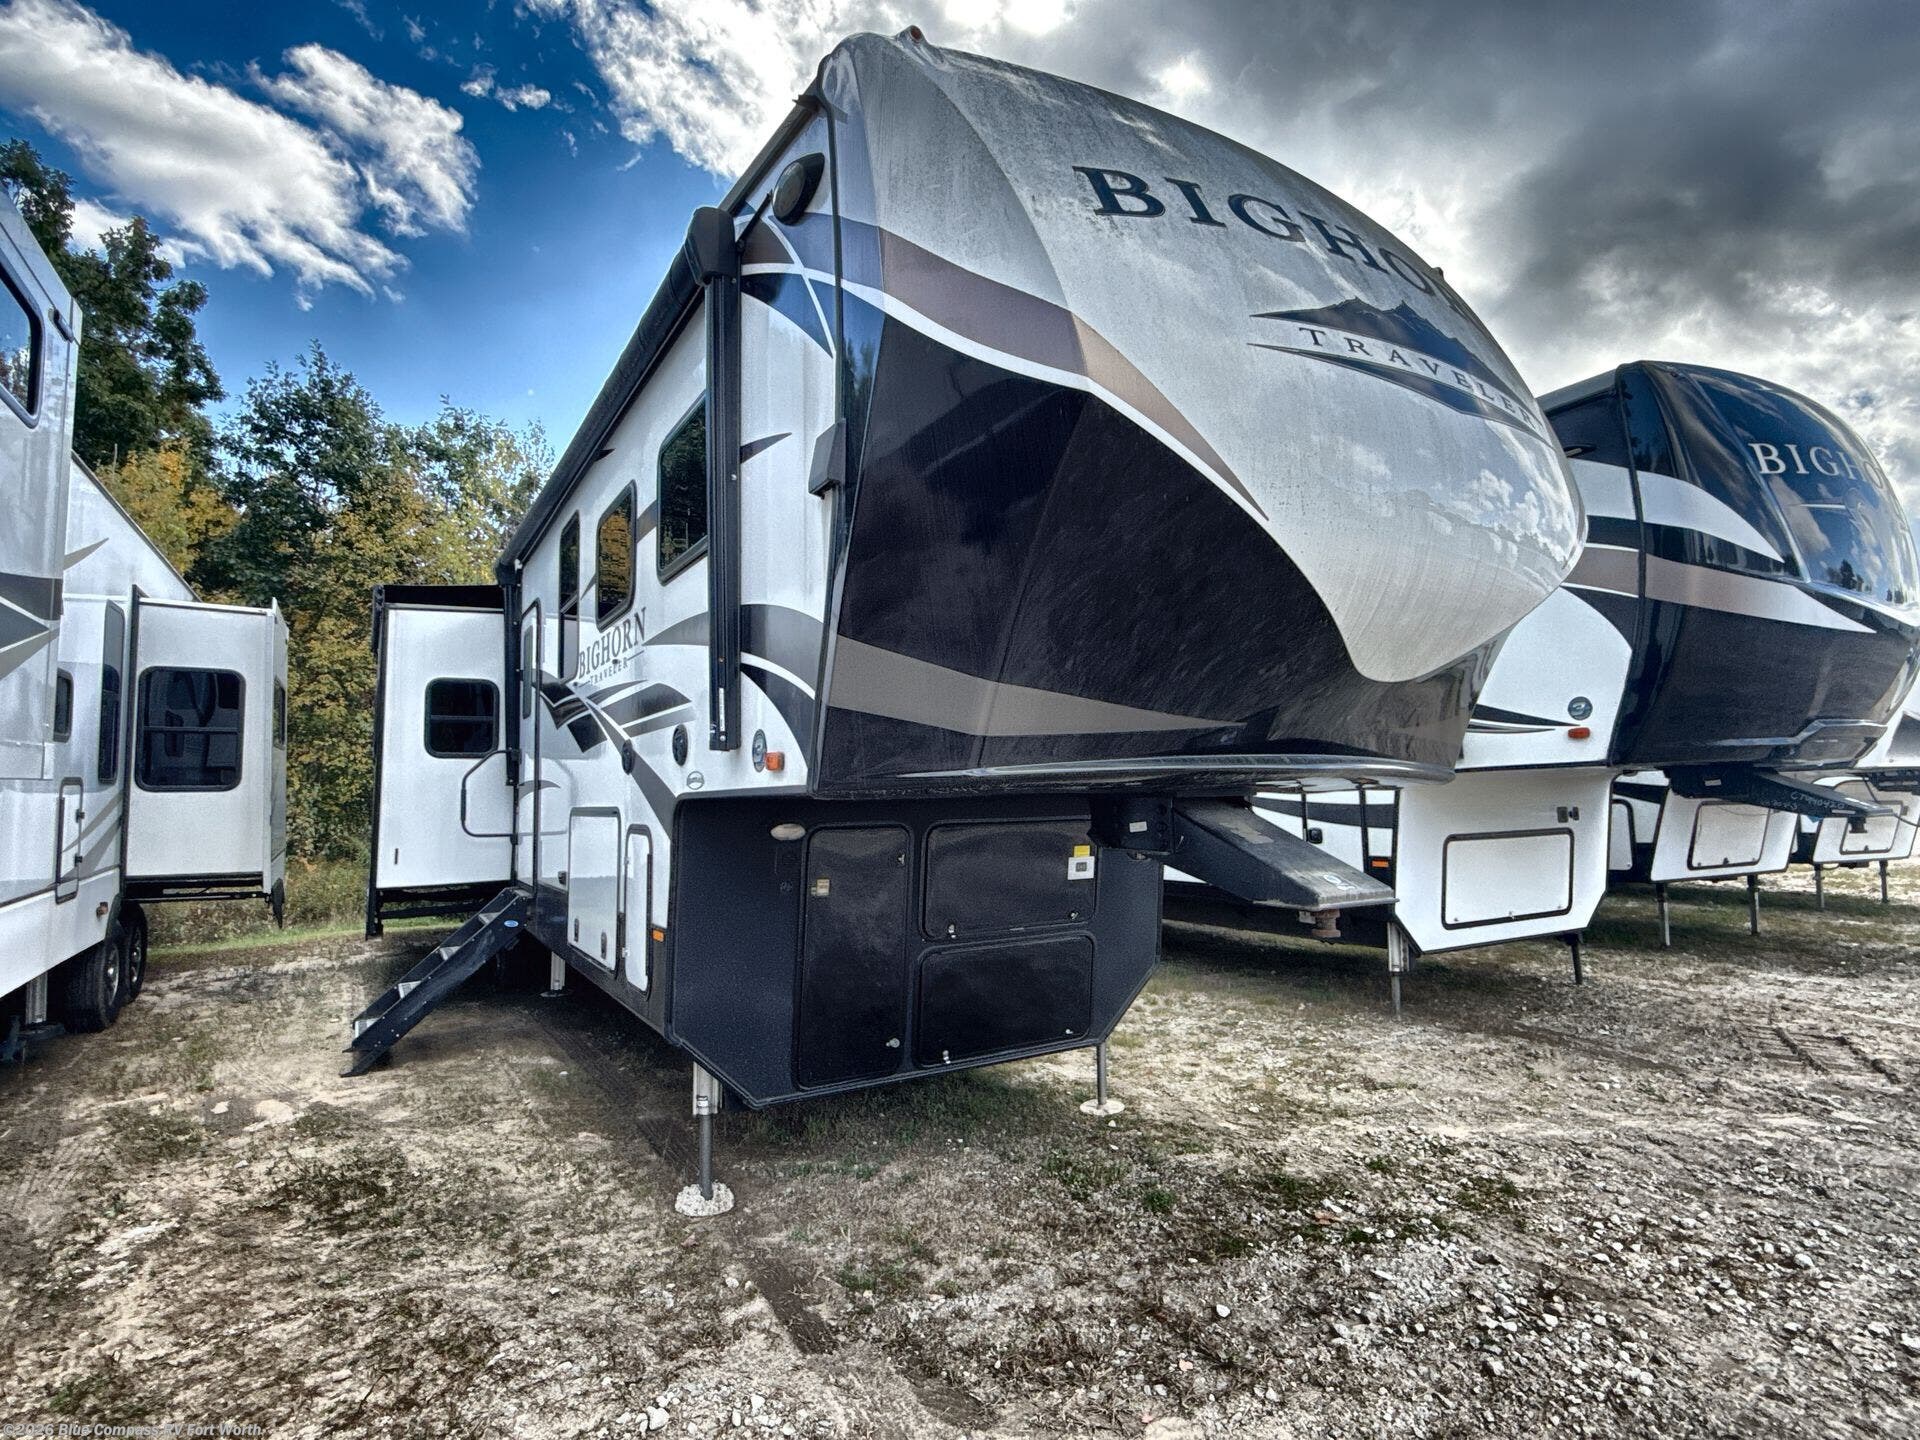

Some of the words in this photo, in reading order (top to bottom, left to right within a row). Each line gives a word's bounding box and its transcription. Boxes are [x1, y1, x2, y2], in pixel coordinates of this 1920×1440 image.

[1299, 326, 1538, 430] TRAVELER
[578, 606, 647, 679] BIGHORN
[590, 657, 629, 685] TRAVELER
